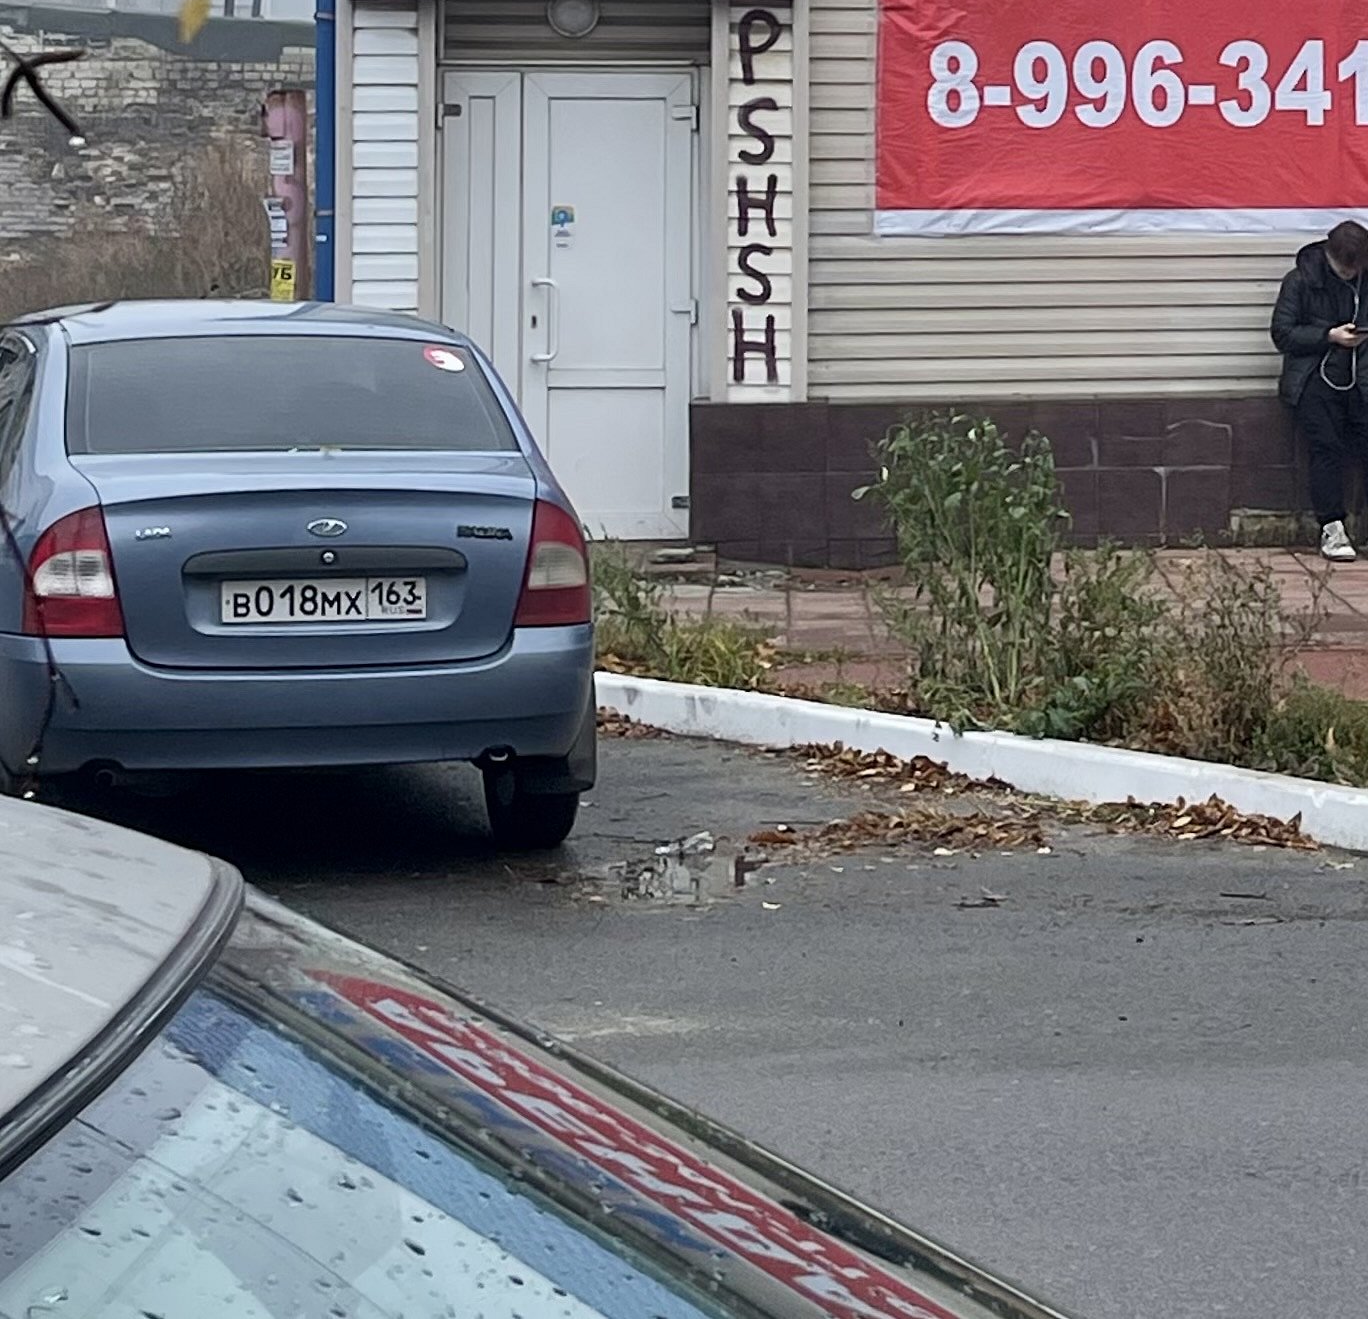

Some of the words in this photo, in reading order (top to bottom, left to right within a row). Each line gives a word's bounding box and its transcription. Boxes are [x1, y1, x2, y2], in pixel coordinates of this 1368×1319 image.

[731, 9, 782, 383] PSHSH
[233, 584, 363, 618] В018МХ
[370, 580, 419, 606] 163
